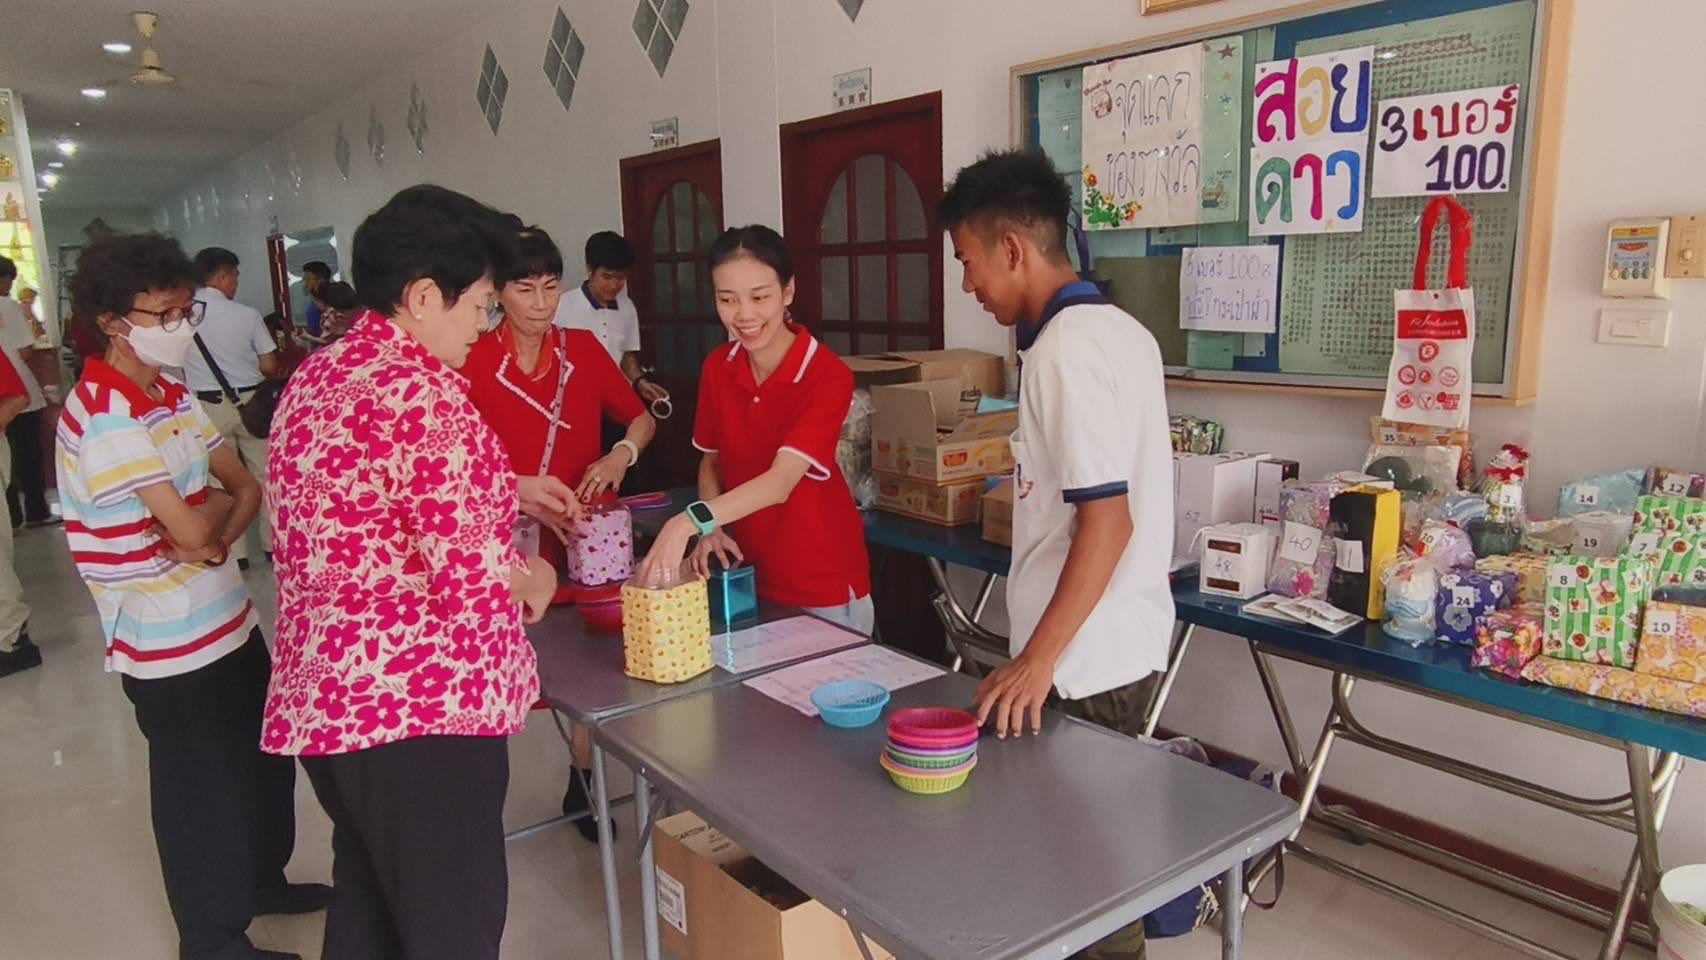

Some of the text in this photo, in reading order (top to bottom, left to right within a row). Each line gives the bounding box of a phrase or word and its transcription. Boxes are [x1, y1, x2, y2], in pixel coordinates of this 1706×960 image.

[1254, 58, 1370, 142] สอย
[1256, 150, 1361, 224] ดาว
[1669, 482, 1685, 493] 12
[1580, 494, 1594, 503] 14
[1289, 535, 1313, 551] 40
[1584, 538, 1598, 548] 19
[1639, 543, 1648, 552] 7
[1559, 575, 1568, 586] 8
[1456, 596, 1471, 606] 24
[1652, 622, 1671, 634] 10
